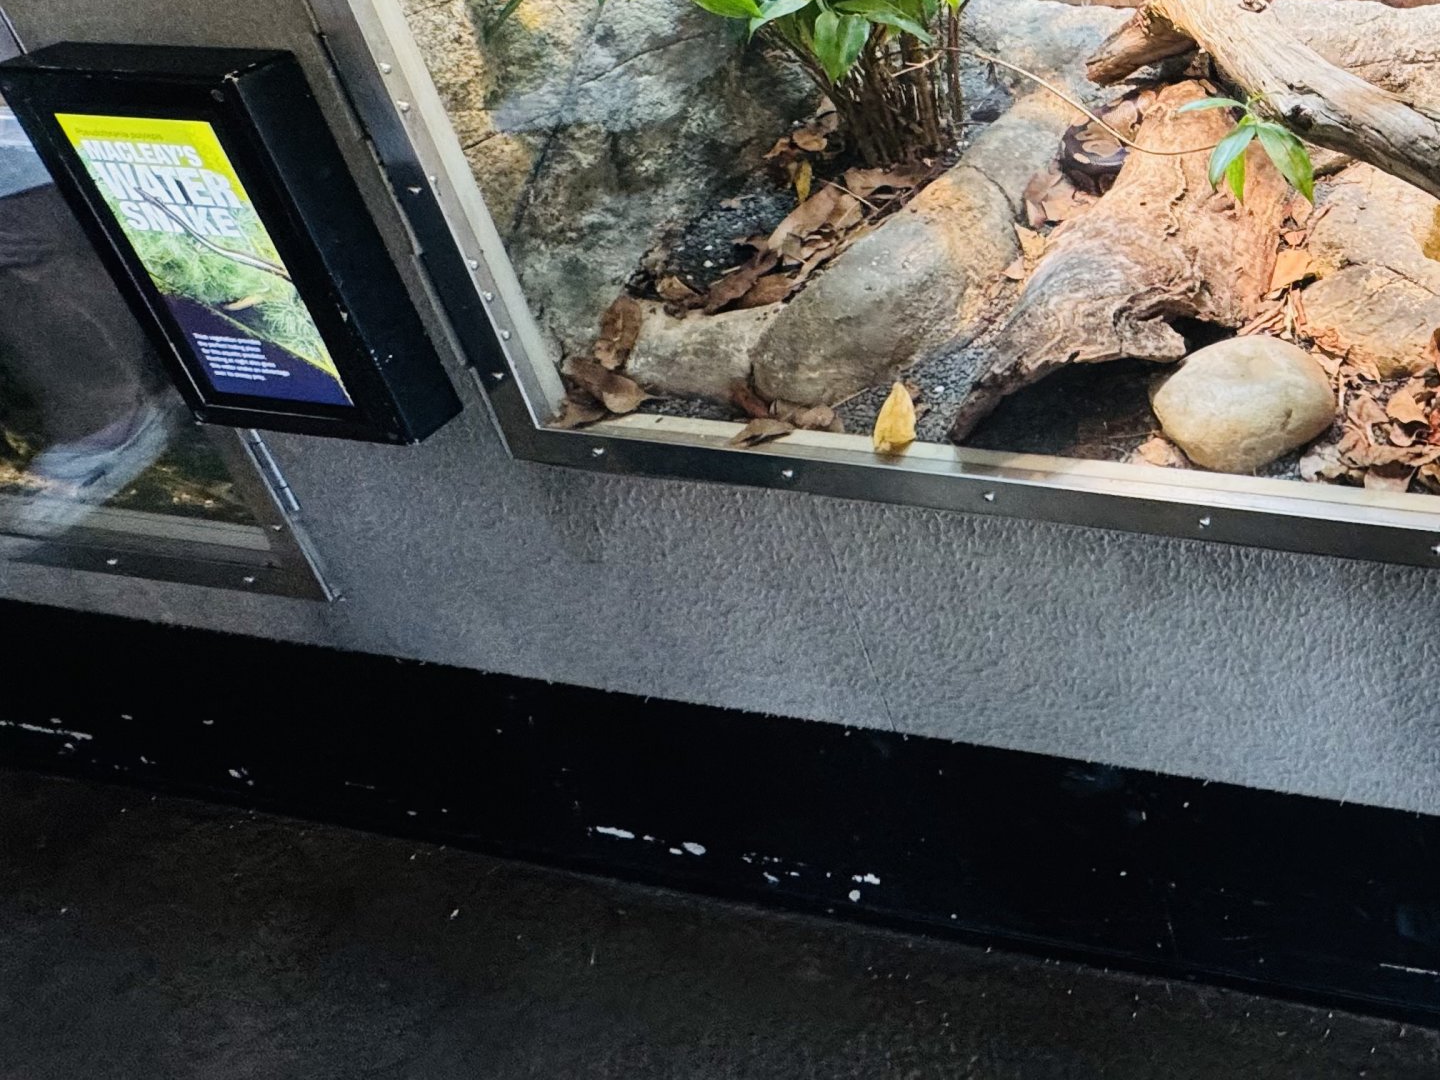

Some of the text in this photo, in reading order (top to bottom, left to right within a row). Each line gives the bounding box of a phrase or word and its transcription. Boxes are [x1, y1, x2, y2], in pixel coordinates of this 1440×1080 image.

[82, 140, 203, 167] MACLEAY'S
[94, 161, 240, 207] WATER
[117, 200, 241, 237] SNAKE
